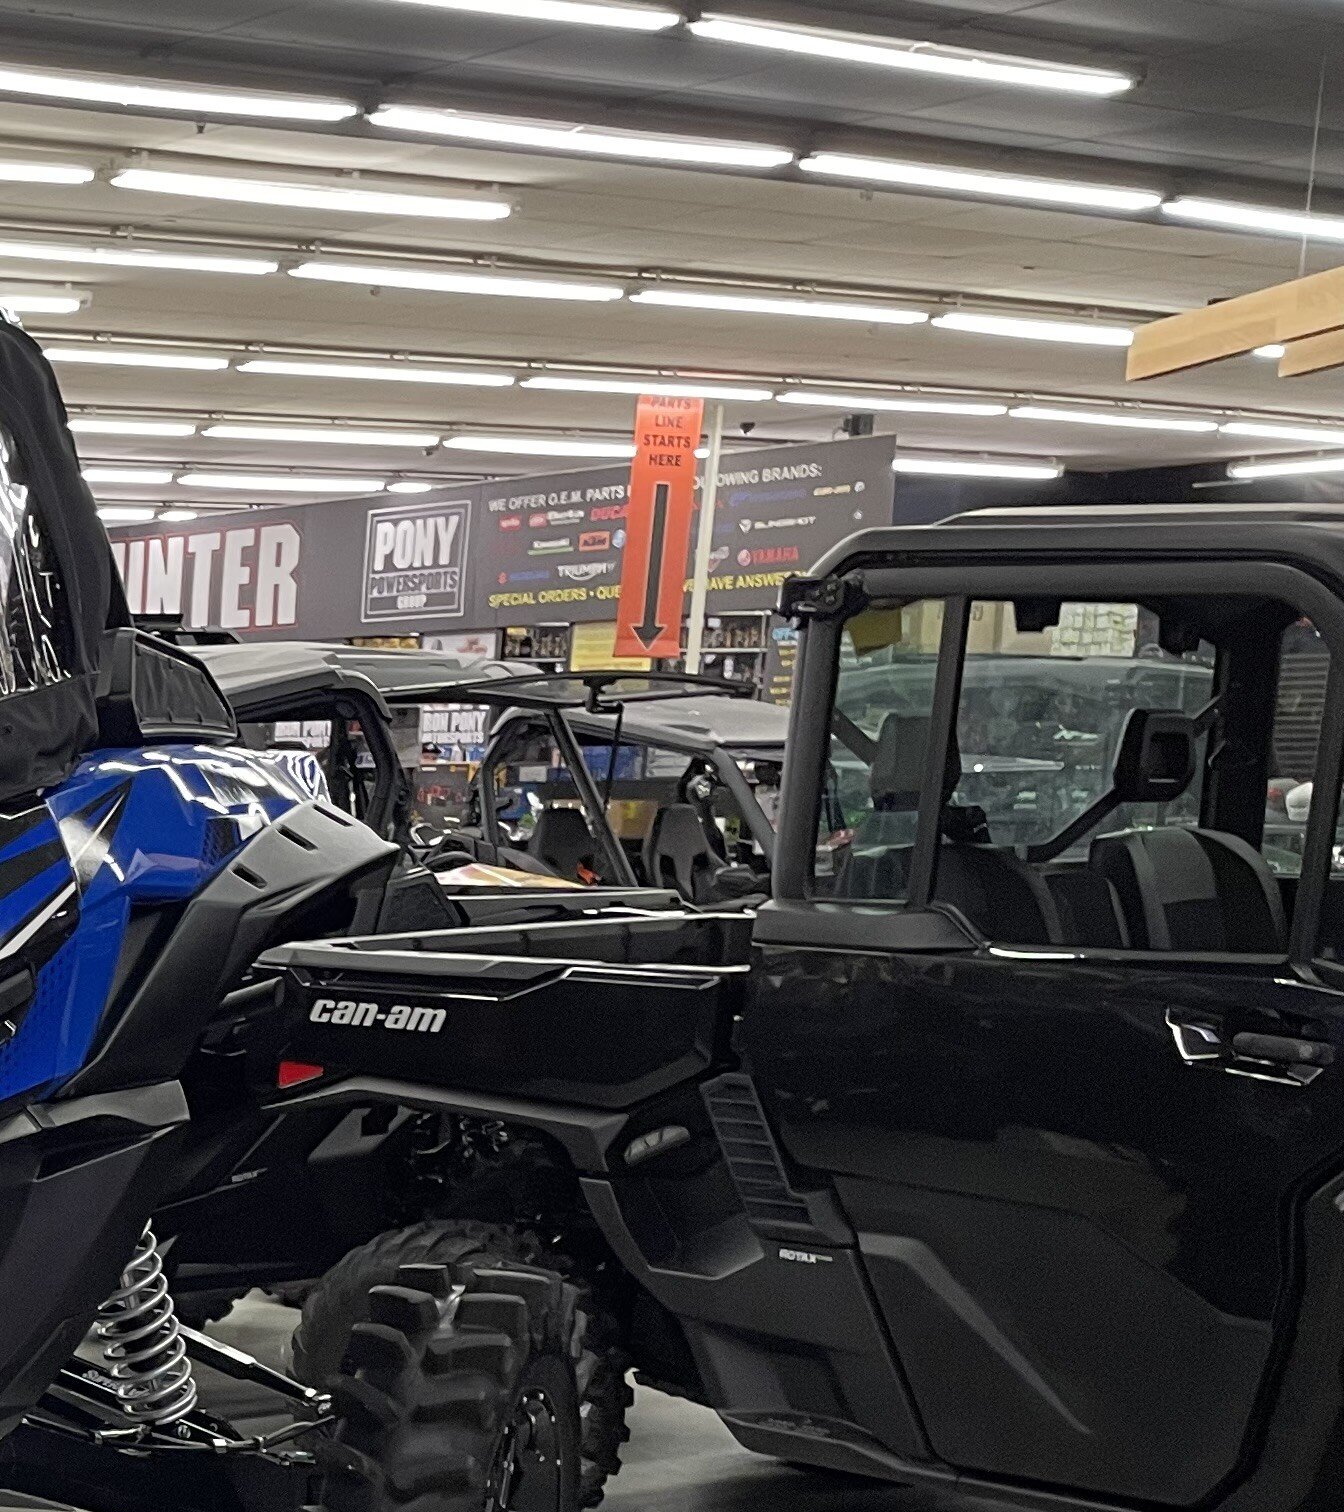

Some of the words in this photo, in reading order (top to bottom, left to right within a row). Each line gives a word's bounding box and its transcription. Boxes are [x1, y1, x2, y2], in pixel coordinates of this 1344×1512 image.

[650, 397, 692, 410] PARTS
[655, 414, 684, 429] LINE
[643, 434, 691, 449] STARTS
[648, 454, 682, 467] HERE
[488, 498, 506, 512] WE
[508, 493, 547, 510] OFFER
[585, 484, 625, 502] PARTS
[762, 462, 823, 483] BRANDS:
[374, 514, 460, 571] PONY
[110, 522, 301, 628] UNTER
[370, 570, 459, 597] POWERSPORTS
[488, 591, 536, 609] SPECIAL
[538, 586, 588, 604] ORDERS
[309, 999, 447, 1033] can-am
